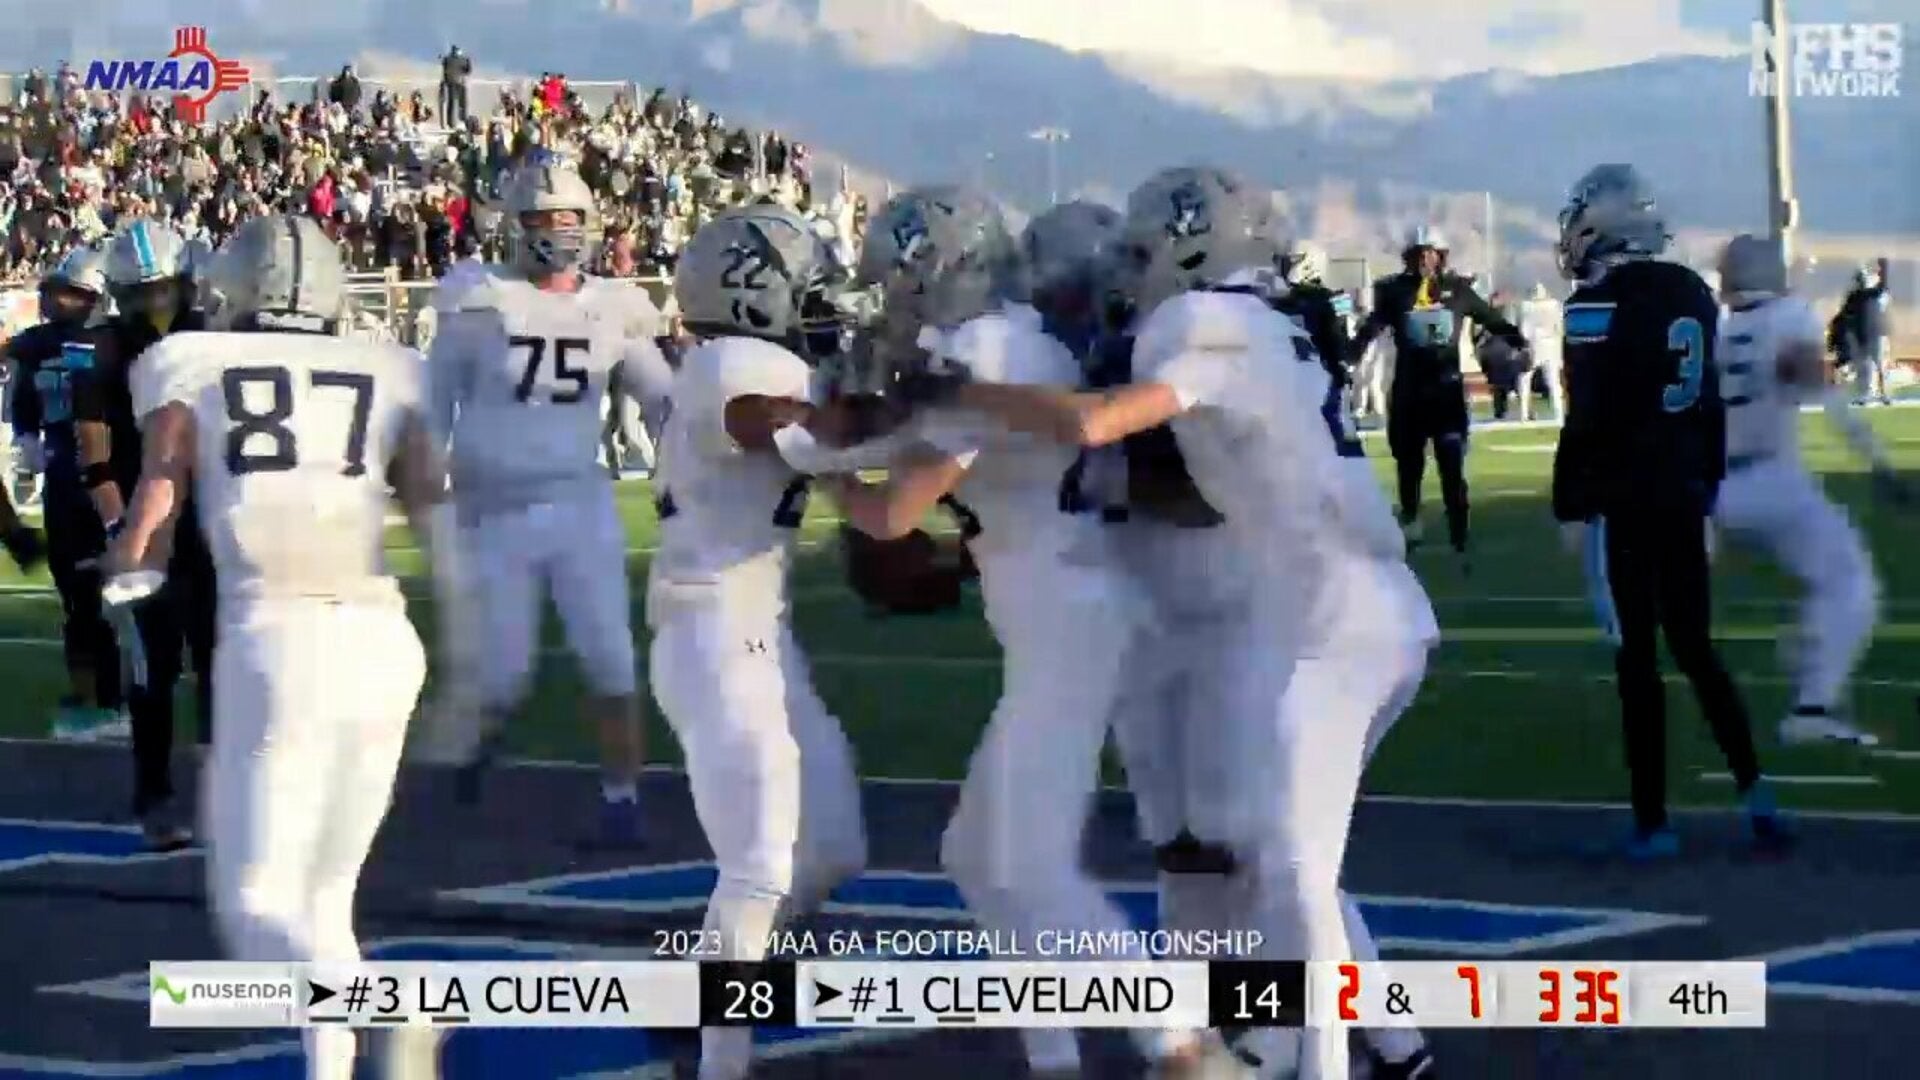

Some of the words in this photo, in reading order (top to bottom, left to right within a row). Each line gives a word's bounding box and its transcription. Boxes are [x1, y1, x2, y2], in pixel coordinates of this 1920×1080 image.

[721, 247, 768, 289] 22
[508, 335, 590, 403] 75
[1663, 316, 1704, 413] 3
[223, 365, 374, 478] 87
